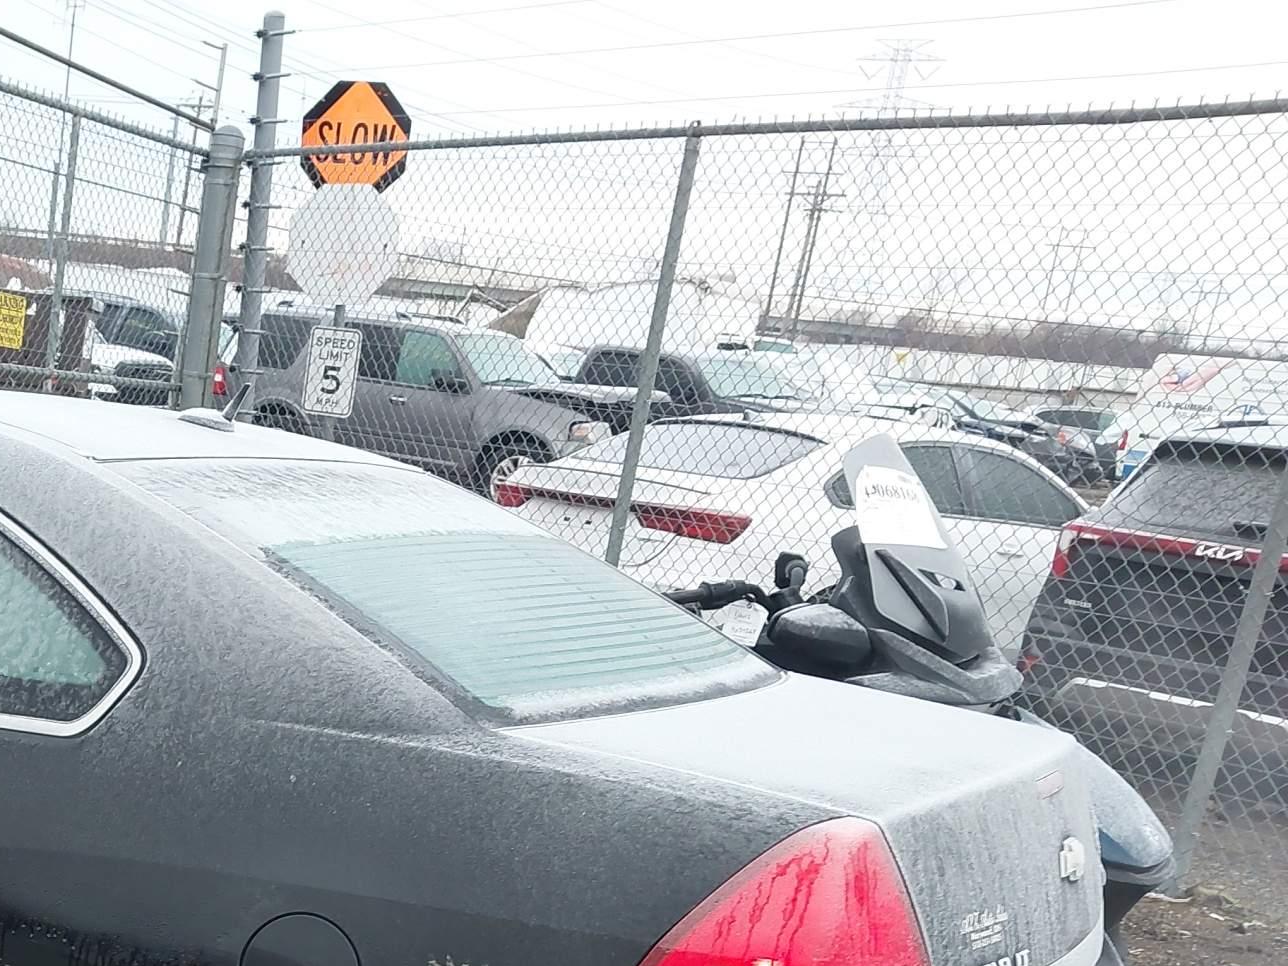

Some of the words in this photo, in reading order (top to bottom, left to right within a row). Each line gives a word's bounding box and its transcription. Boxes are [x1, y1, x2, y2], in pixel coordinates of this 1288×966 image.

[315, 120, 397, 166] SLOW
[315, 336, 356, 350] SPEED
[319, 349, 351, 362] LIMIT
[320, 364, 342, 395] 5
